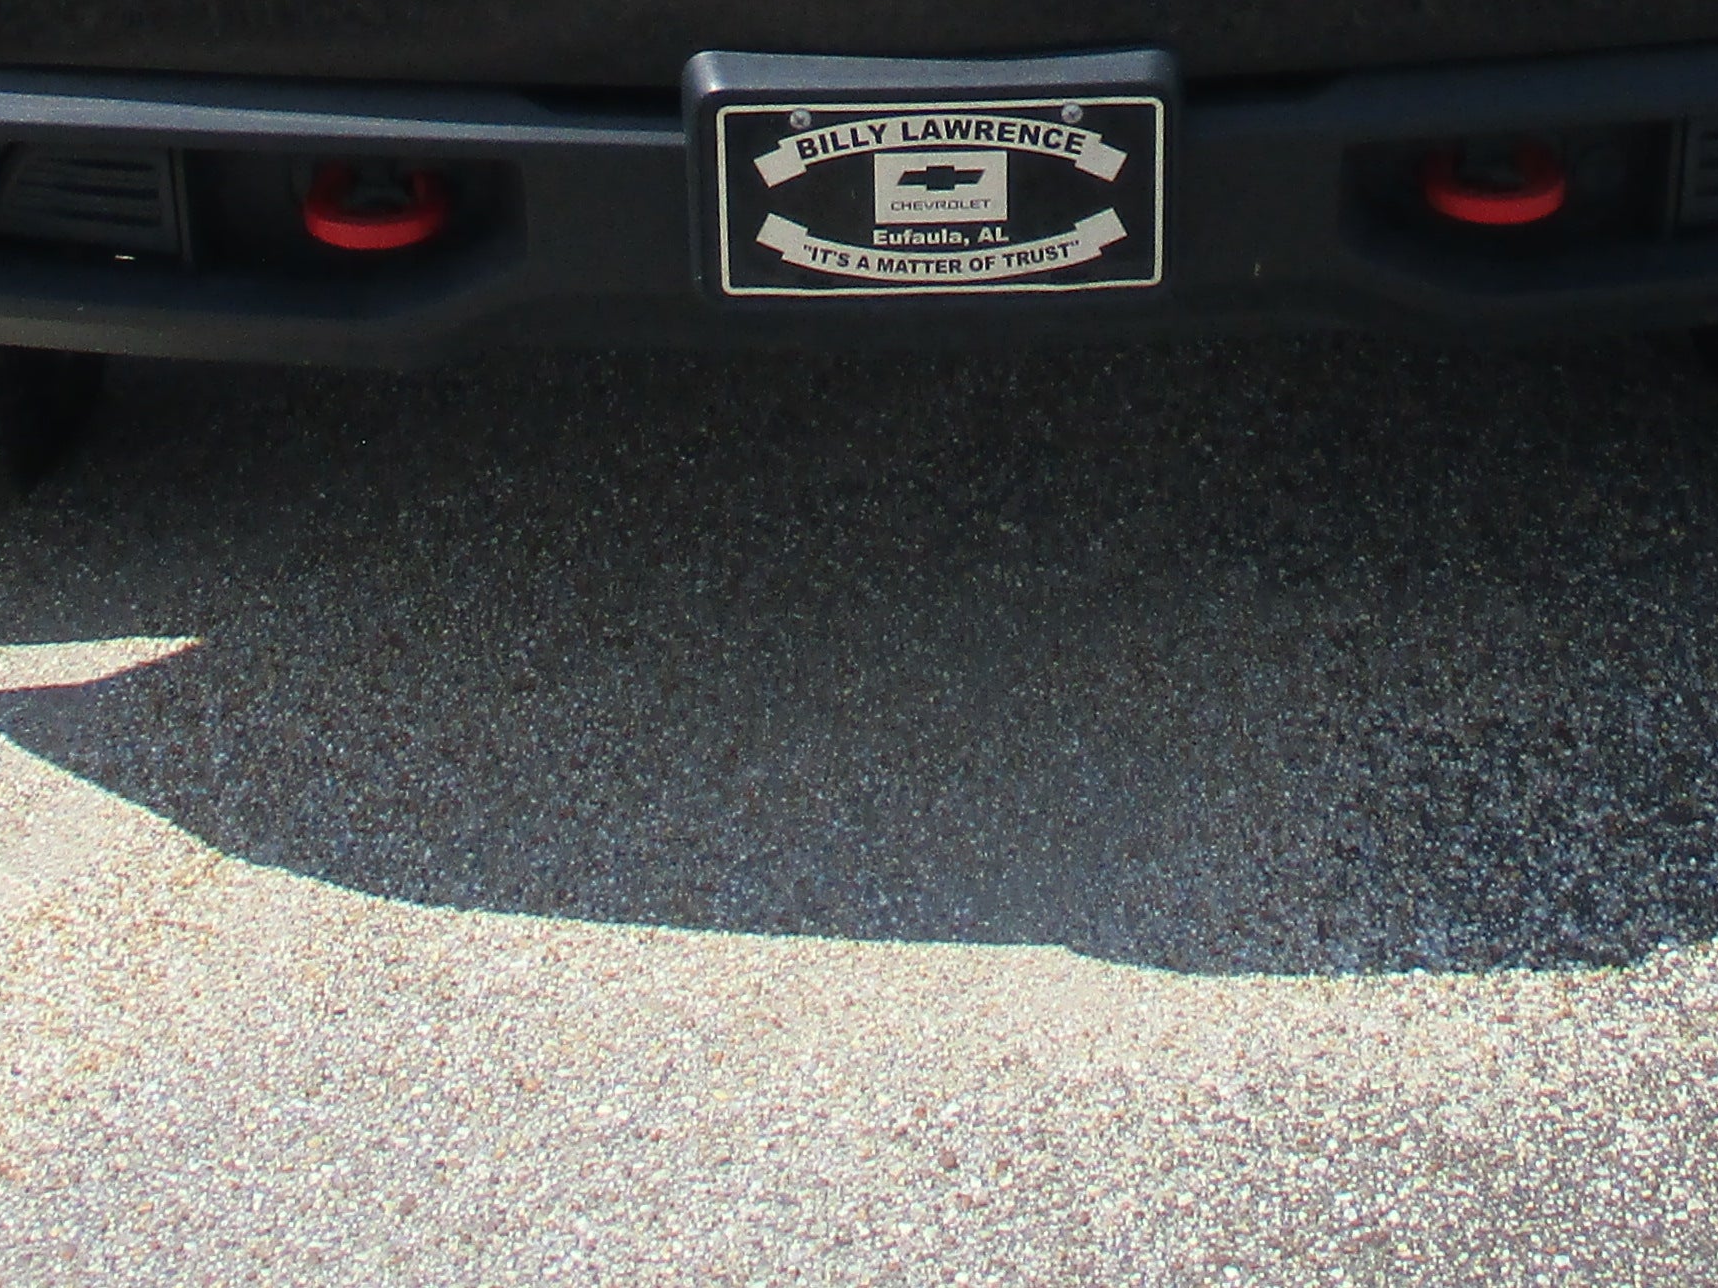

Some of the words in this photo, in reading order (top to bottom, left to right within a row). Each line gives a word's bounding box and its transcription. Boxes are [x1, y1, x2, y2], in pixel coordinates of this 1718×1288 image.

[796, 123, 887, 160] BILLY
[902, 119, 1086, 156] LAWRENCE
[891, 199, 991, 211] CHEVROLET
[873, 228, 970, 246] Eufaula,
[977, 226, 1009, 243] AL
[803, 244, 851, 267] "IT'S
[856, 255, 871, 270] A
[877, 257, 962, 274] MATTER
[969, 255, 996, 272] OF
[1002, 239, 1080, 267] TRUST"
